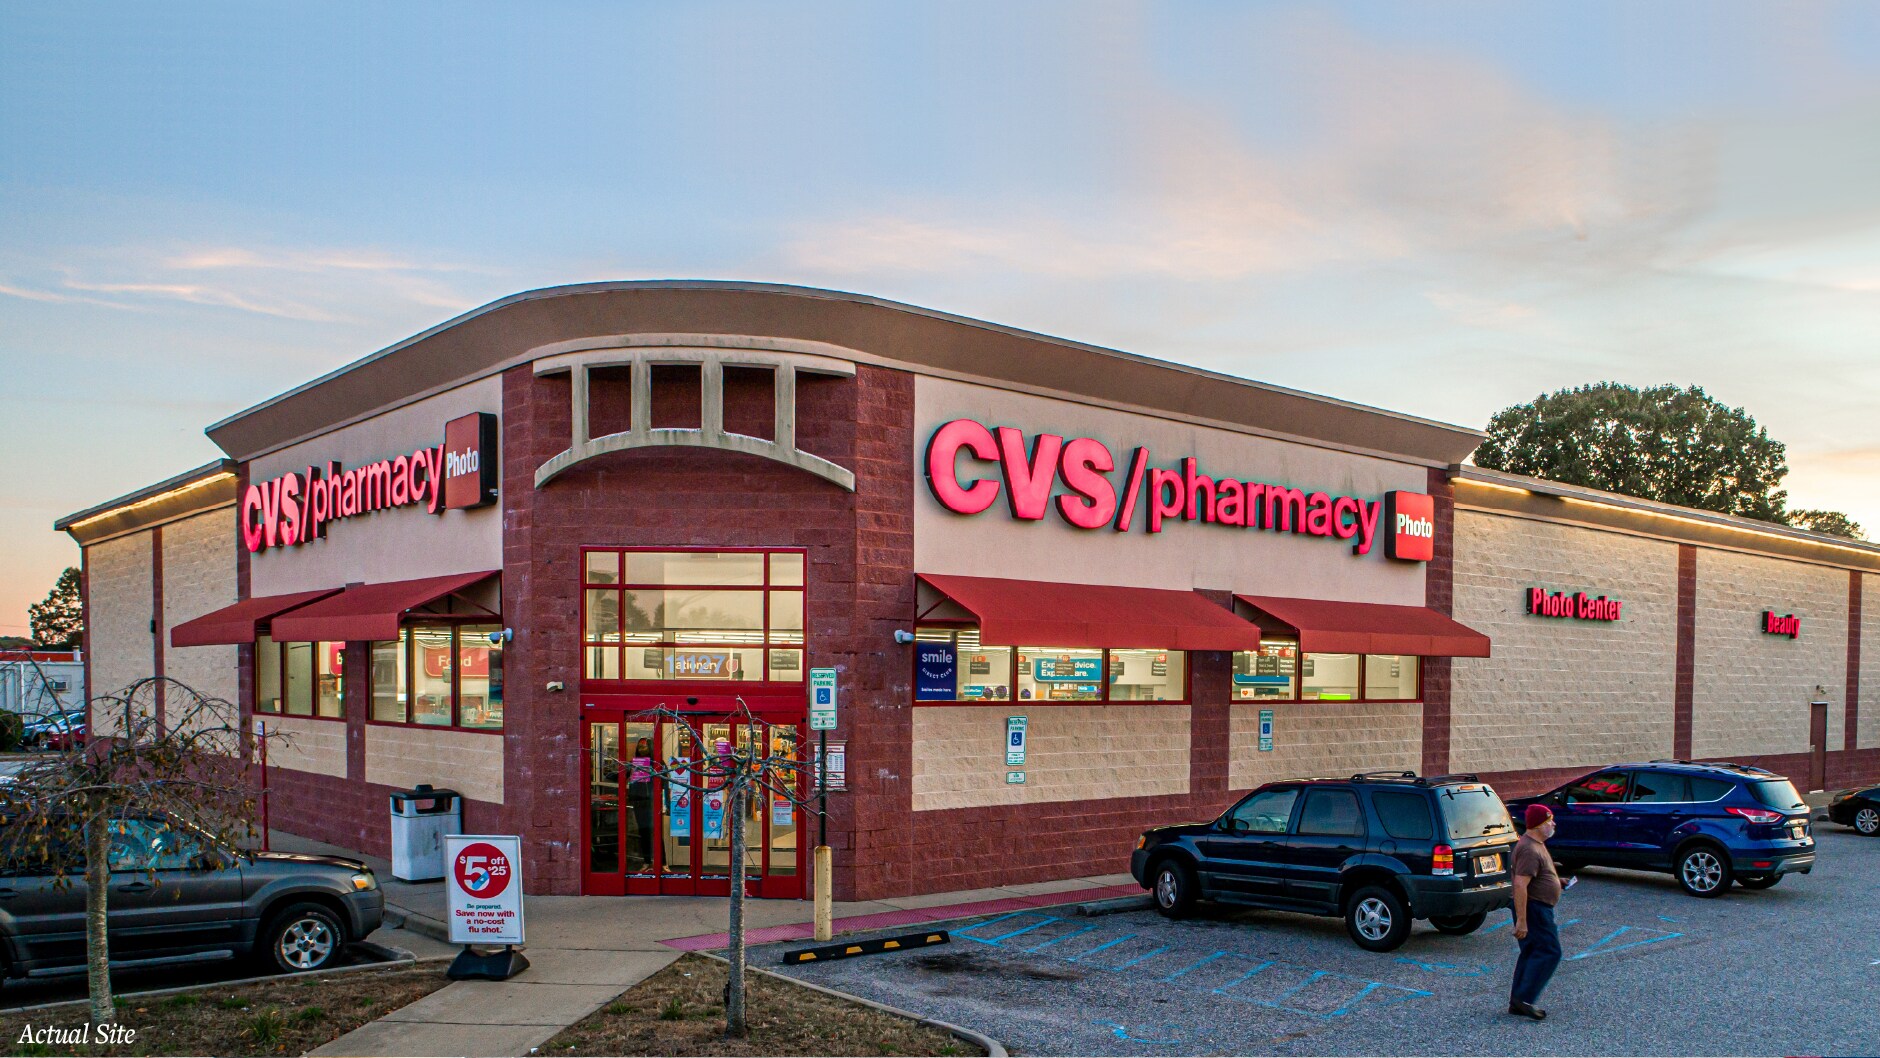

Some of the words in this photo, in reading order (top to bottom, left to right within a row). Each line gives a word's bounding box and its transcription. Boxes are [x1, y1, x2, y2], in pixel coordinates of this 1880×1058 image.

[446, 447, 479, 479] Photo
[1396, 512, 1434, 539] Photo
[1529, 587, 1575, 617] Photo
[1577, 591, 1623, 621] Center
[1765, 611, 1800, 639] Beauty
[438, 655, 472, 667] Fod
[665, 654, 726, 674] 11127
[921, 649, 953, 663] smile
[1075, 661, 1096, 669] dvice.
[491, 856, 505, 865] off
[455, 909, 475, 917] Save
